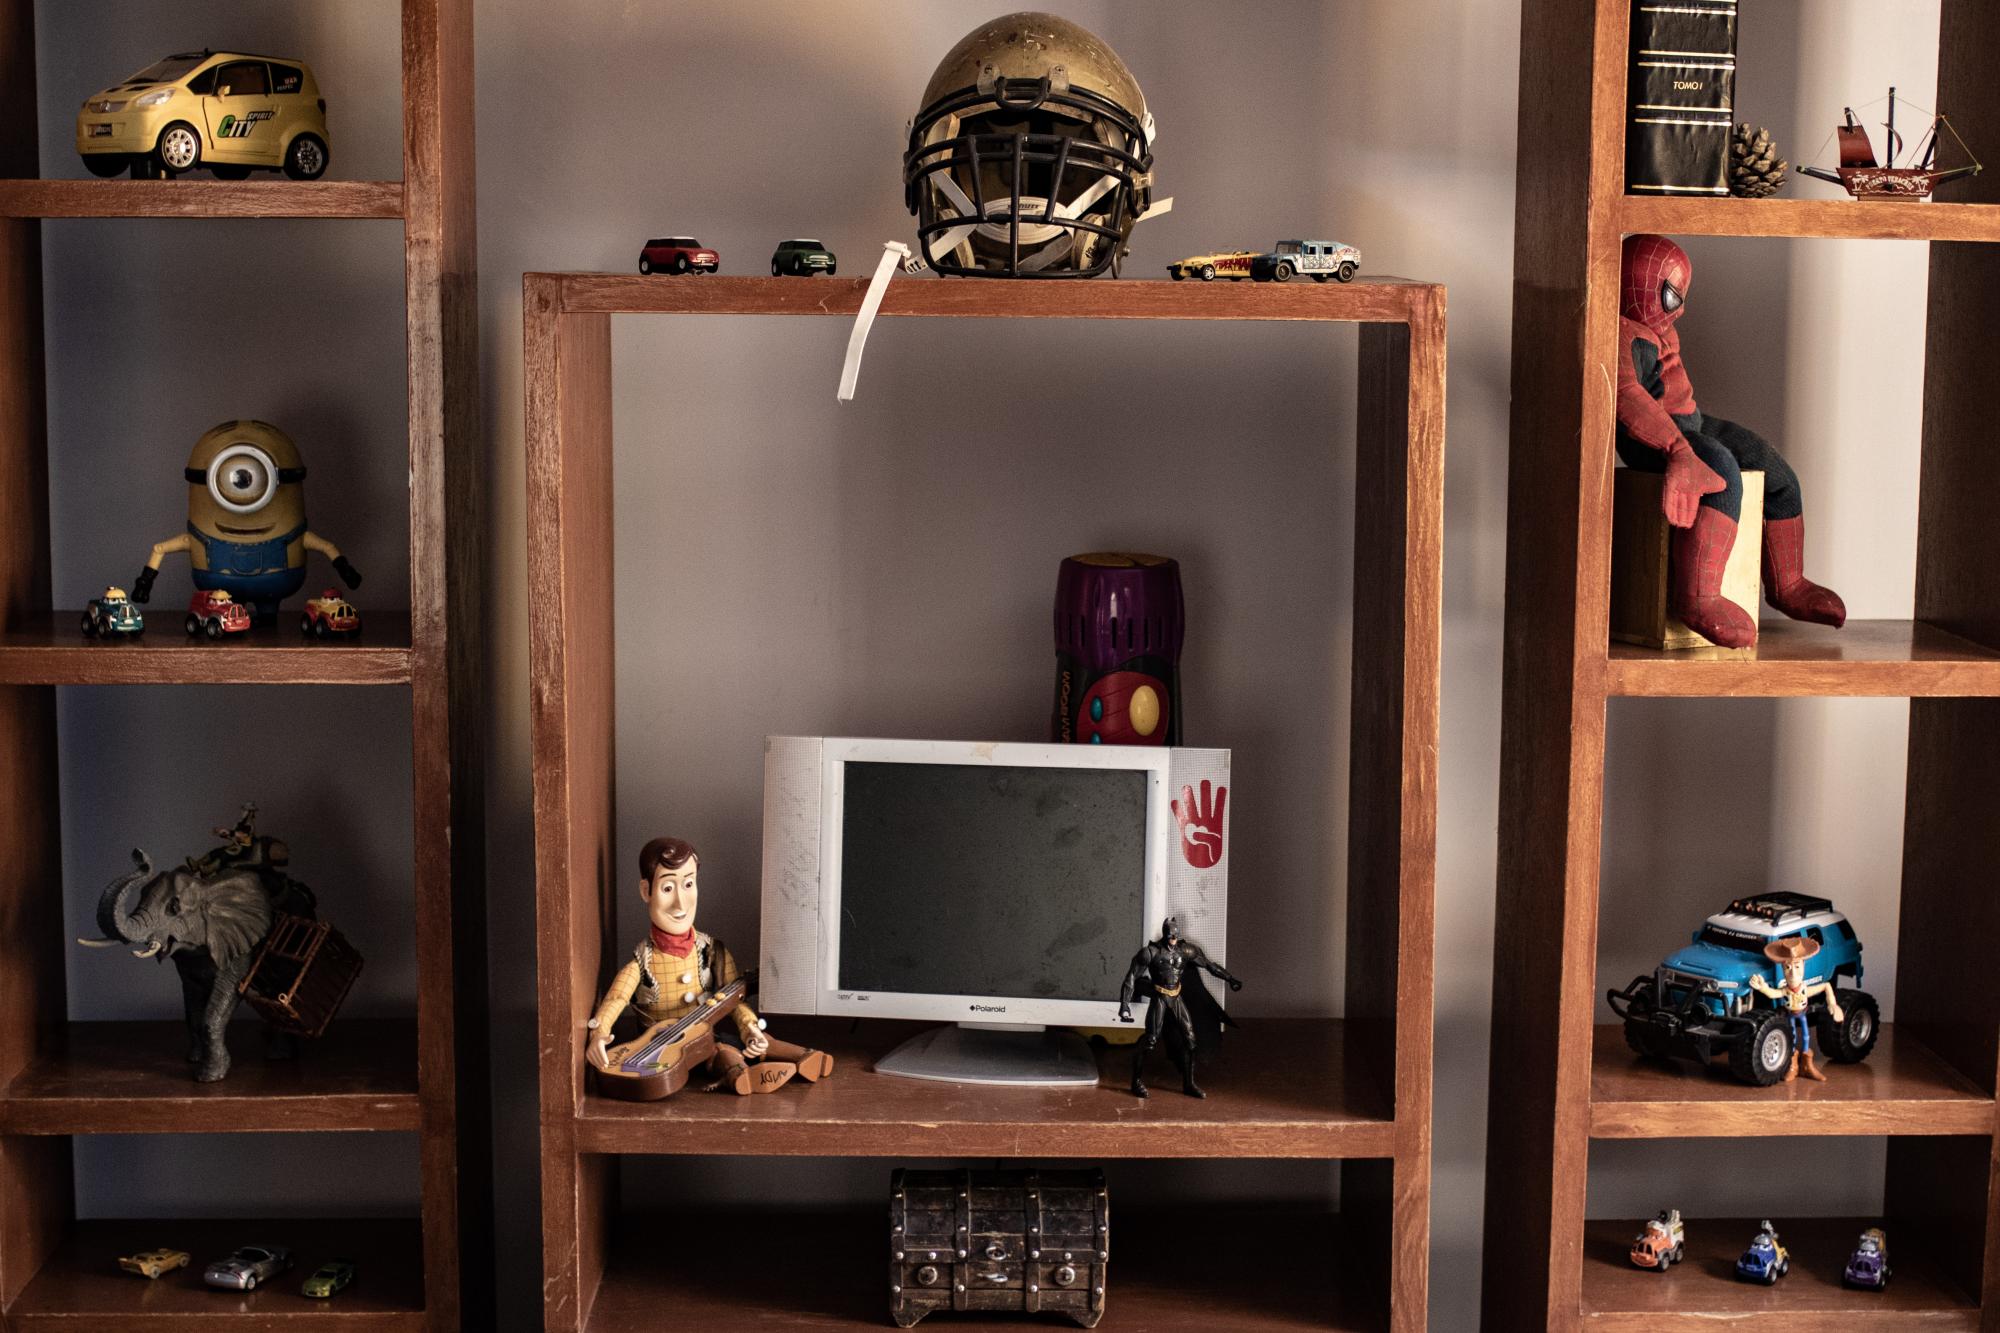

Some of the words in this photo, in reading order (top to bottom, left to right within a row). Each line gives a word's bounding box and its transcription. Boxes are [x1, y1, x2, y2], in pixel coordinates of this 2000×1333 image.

[1673, 81, 1699, 90] TOMO
[217, 114, 257, 138] CITY
[247, 112, 272, 120] SPIRIT
[975, 1004, 1006, 1013] Polaroid
[760, 1070, 788, 1085] ANDY
